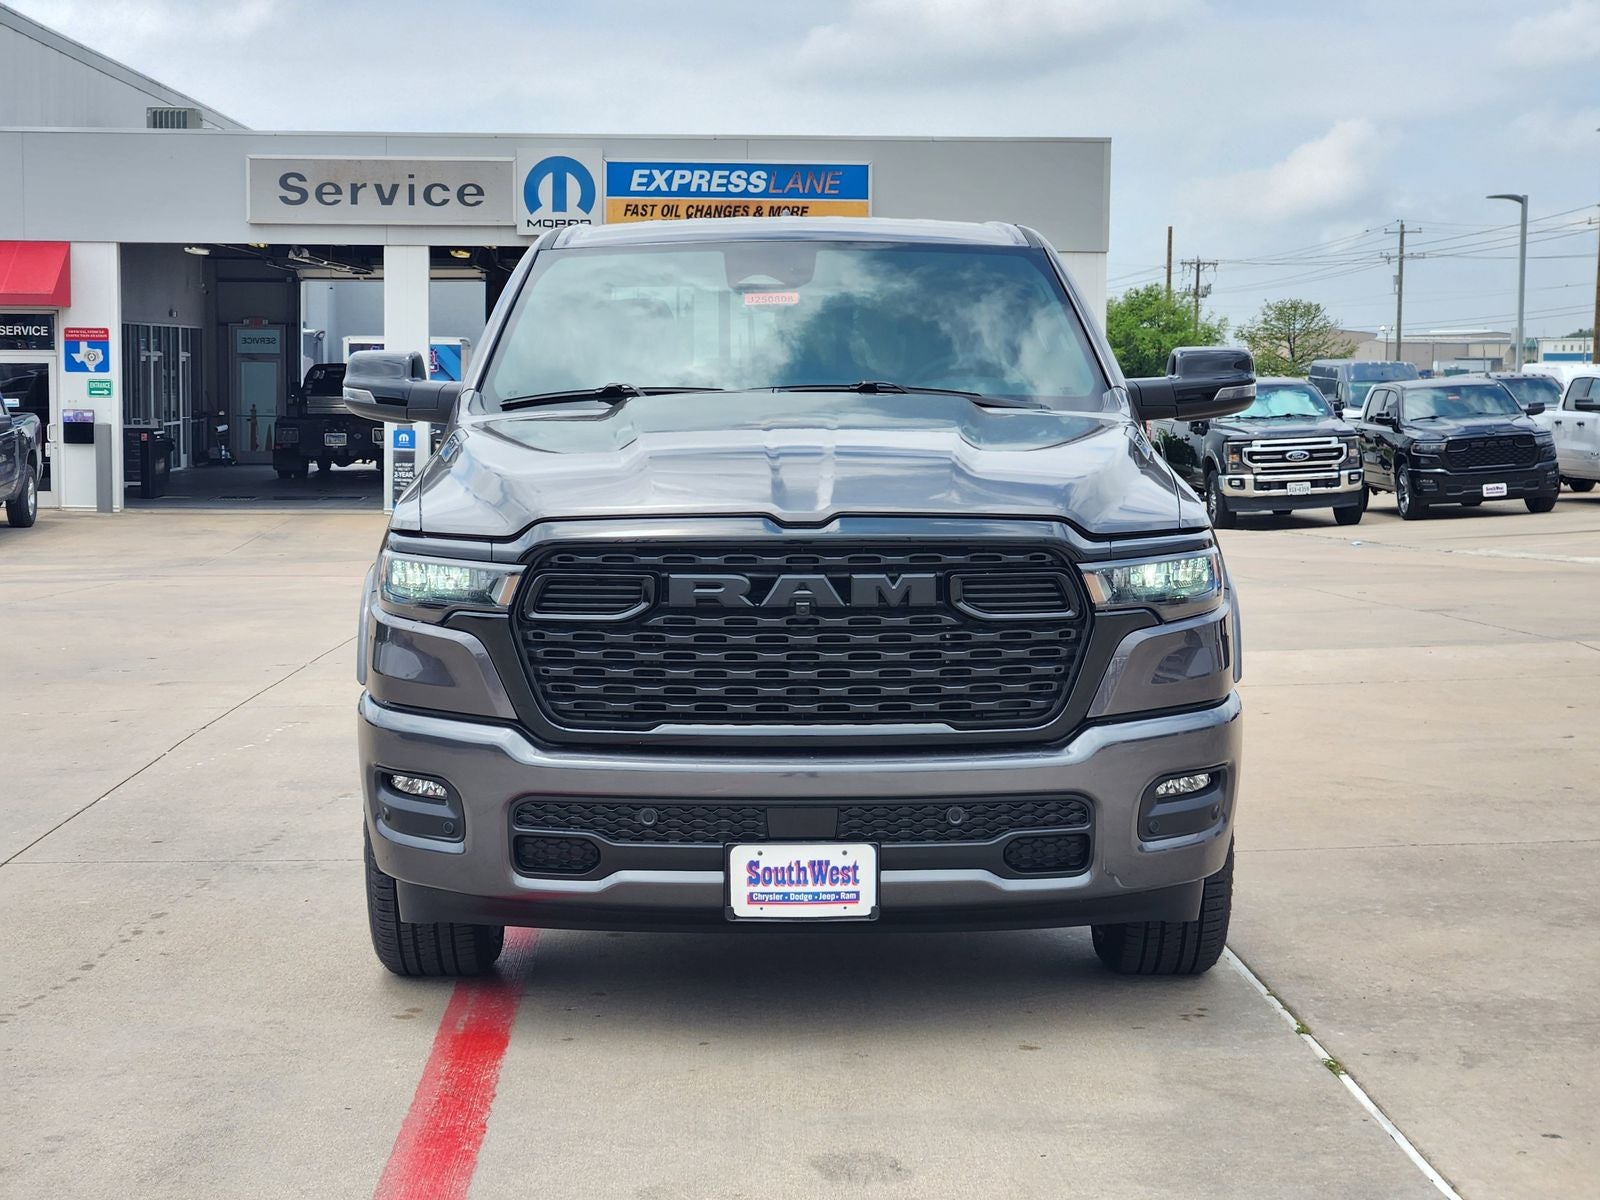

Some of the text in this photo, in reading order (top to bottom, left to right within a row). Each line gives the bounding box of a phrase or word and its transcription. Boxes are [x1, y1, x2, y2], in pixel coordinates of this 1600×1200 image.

[278, 172, 485, 206] Service
[624, 204, 657, 217] FAST
[660, 204, 681, 217] OIL
[685, 204, 750, 219] CHANGES
[752, 205, 764, 217] &
[0, 326, 48, 336] SERVICE
[668, 574, 937, 607] RAM
[746, 859, 860, 887] SouthWest
[752, 892, 857, 901] Chrysler Dodge Jeep Ram
